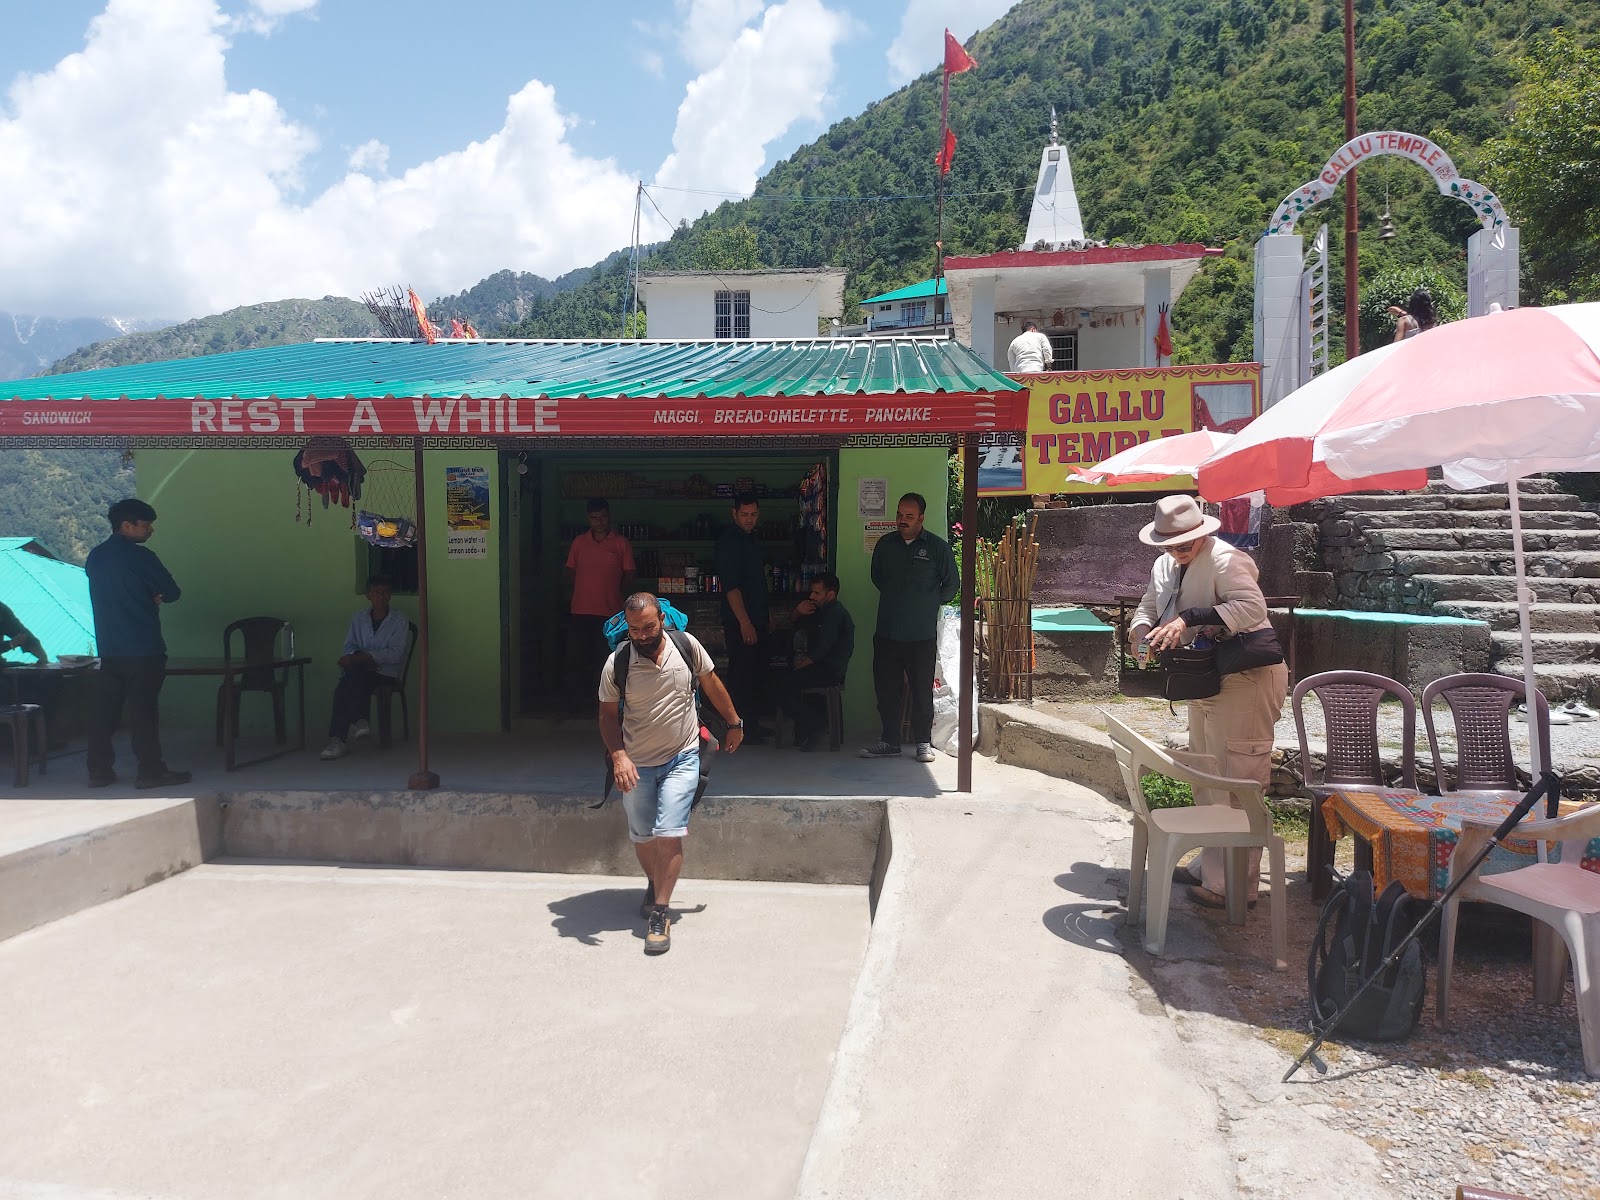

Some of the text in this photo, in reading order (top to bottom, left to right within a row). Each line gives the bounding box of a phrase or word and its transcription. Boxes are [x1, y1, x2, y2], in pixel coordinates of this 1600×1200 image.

[1321, 133, 1442, 185] GALLU TEMPLE
[22, 411, 92, 425] SANDWICH
[191, 399, 561, 433] REST A WHILE
[653, 409, 704, 425] MAGGI,
[1048, 389, 1166, 425] GALLU
[1031, 428, 1185, 464] TEMP
[448, 536, 463, 544] Lemon
